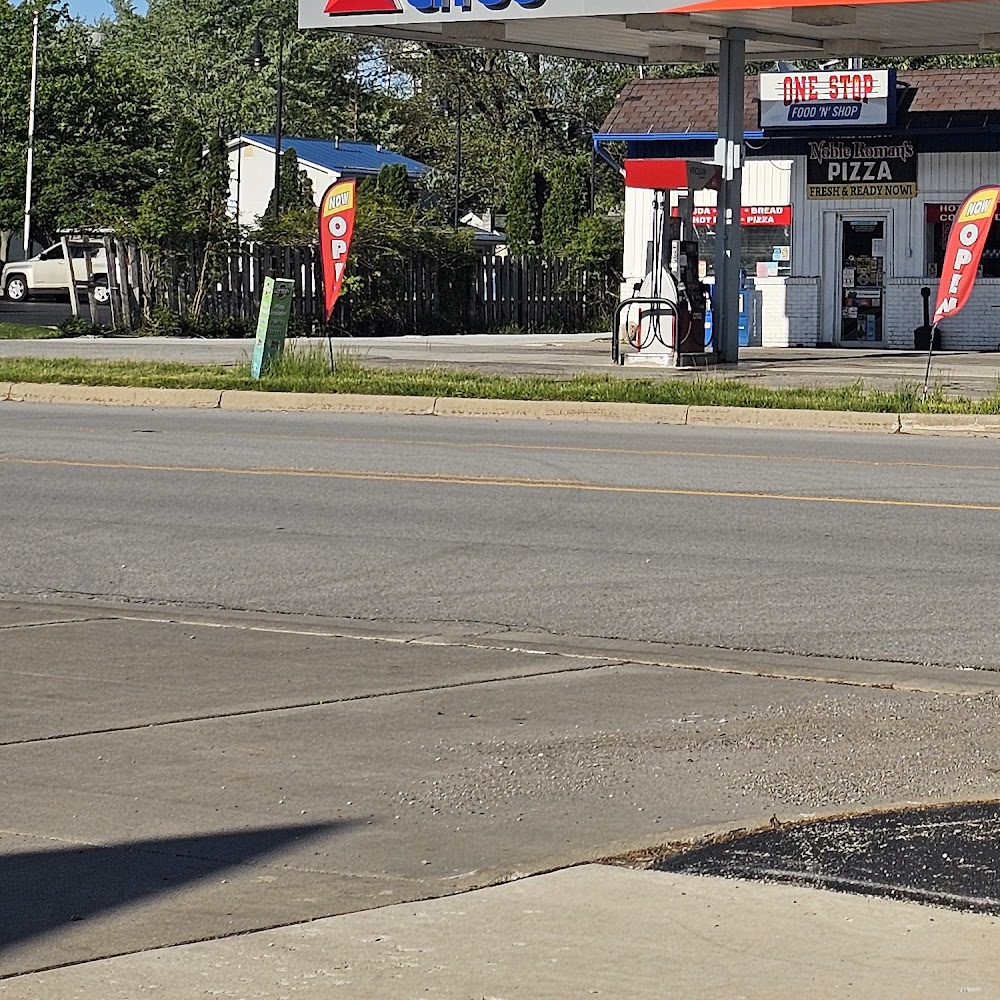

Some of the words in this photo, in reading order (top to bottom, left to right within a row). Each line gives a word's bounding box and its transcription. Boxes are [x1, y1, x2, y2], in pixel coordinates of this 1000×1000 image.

[783, 76, 818, 105] ONE
[829, 74, 873, 104] STOP
[791, 105, 816, 118] FOOD
[832, 105, 858, 117] SHOP
[808, 140, 851, 164] Noble
[852, 140, 914, 163] Roman's
[828, 161, 892, 181] PIZZA
[328, 191, 350, 210] NOW
[809, 187, 840, 197] FRESH
[841, 187, 849, 197] &
[850, 186, 883, 196] READY
[751, 207, 783, 215] BREAD
[966, 198, 992, 217] NOW
[747, 216, 774, 224] PIZZA
